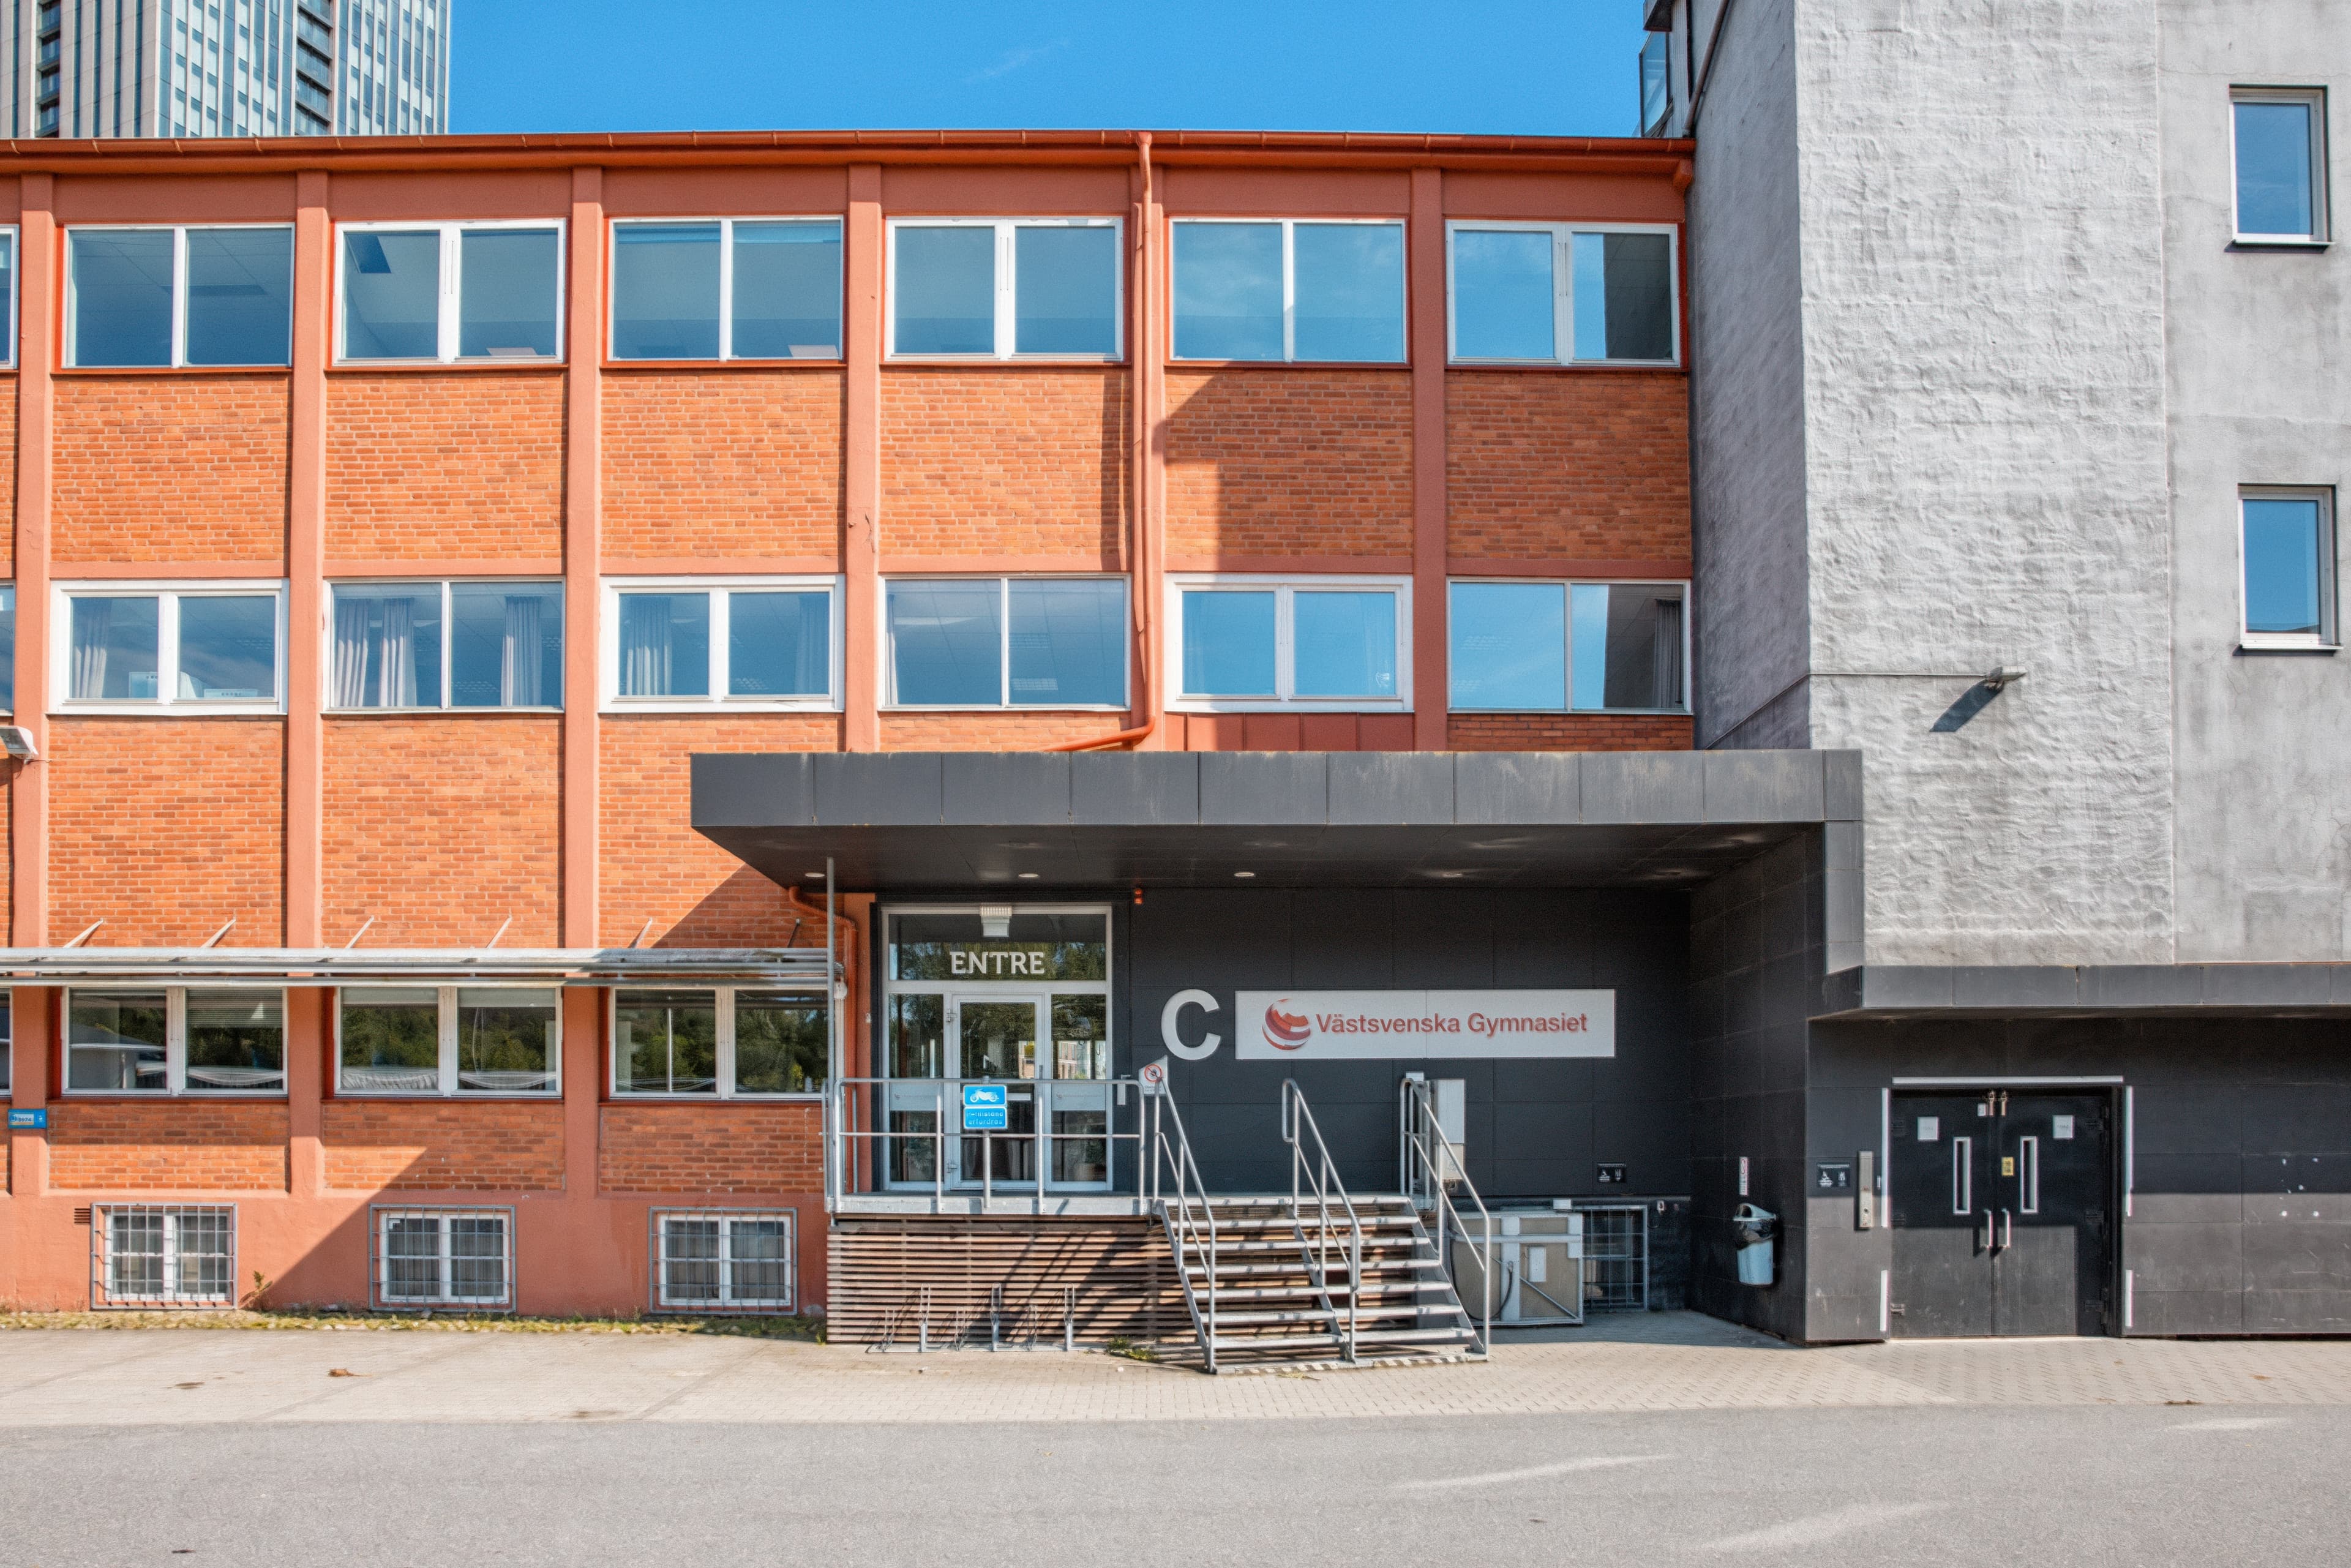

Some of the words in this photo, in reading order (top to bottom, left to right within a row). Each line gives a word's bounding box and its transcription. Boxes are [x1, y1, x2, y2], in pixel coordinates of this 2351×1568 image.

[950, 951, 1044, 974] ENTRE
[1161, 989, 1221, 1060] C
[1316, 1013, 1461, 1033] Västsvenska
[1468, 1012, 1588, 1037] Gymnasiet
